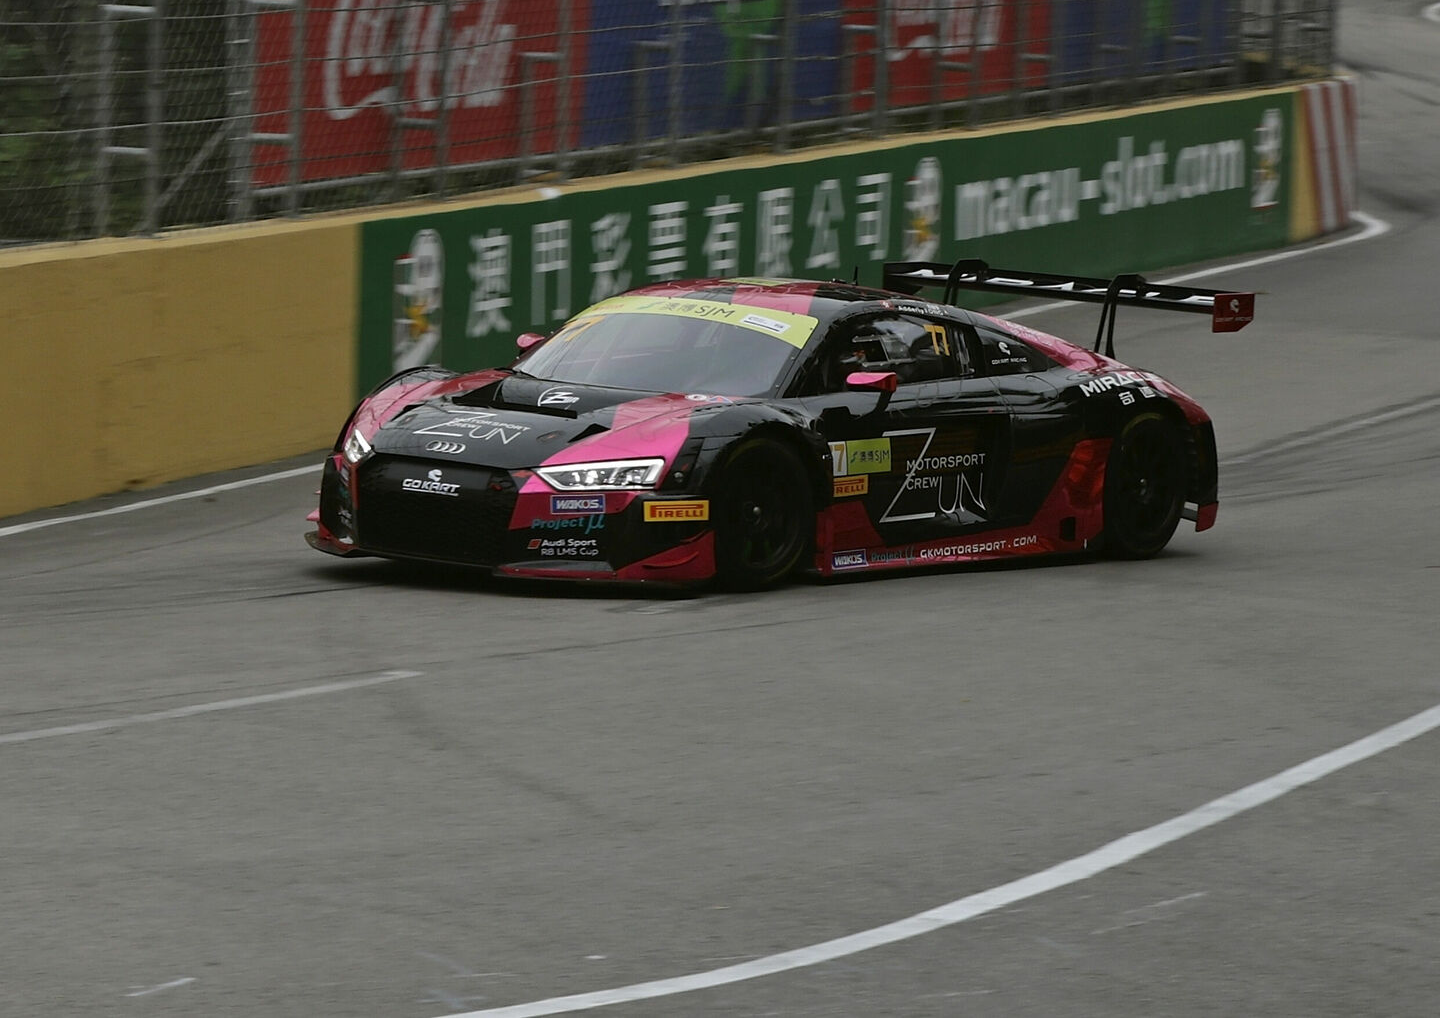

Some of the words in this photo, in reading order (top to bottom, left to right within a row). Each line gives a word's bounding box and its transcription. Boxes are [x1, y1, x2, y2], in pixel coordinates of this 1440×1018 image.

[954, 136, 1245, 241] macau-slot.com
[465, 172, 892, 337] 澳門彩票有限公司
[695, 305, 735, 318] SJM
[923, 324, 950, 356] 77
[829, 444, 845, 472] 7
[874, 449, 890, 463] SJM
[906, 453, 986, 471] MOTORSPORT
[834, 480, 865, 494] RELLI
[906, 476, 939, 490] CREW
[650, 504, 704, 518] PIRELLI
[531, 517, 584, 530] Project
[541, 538, 566, 547] Audi
[567, 538, 597, 549] Sport
[919, 535, 1037, 560] GKMOTORSPORT.COM
[556, 547, 577, 555] LMS
[579, 547, 599, 557] Cup
